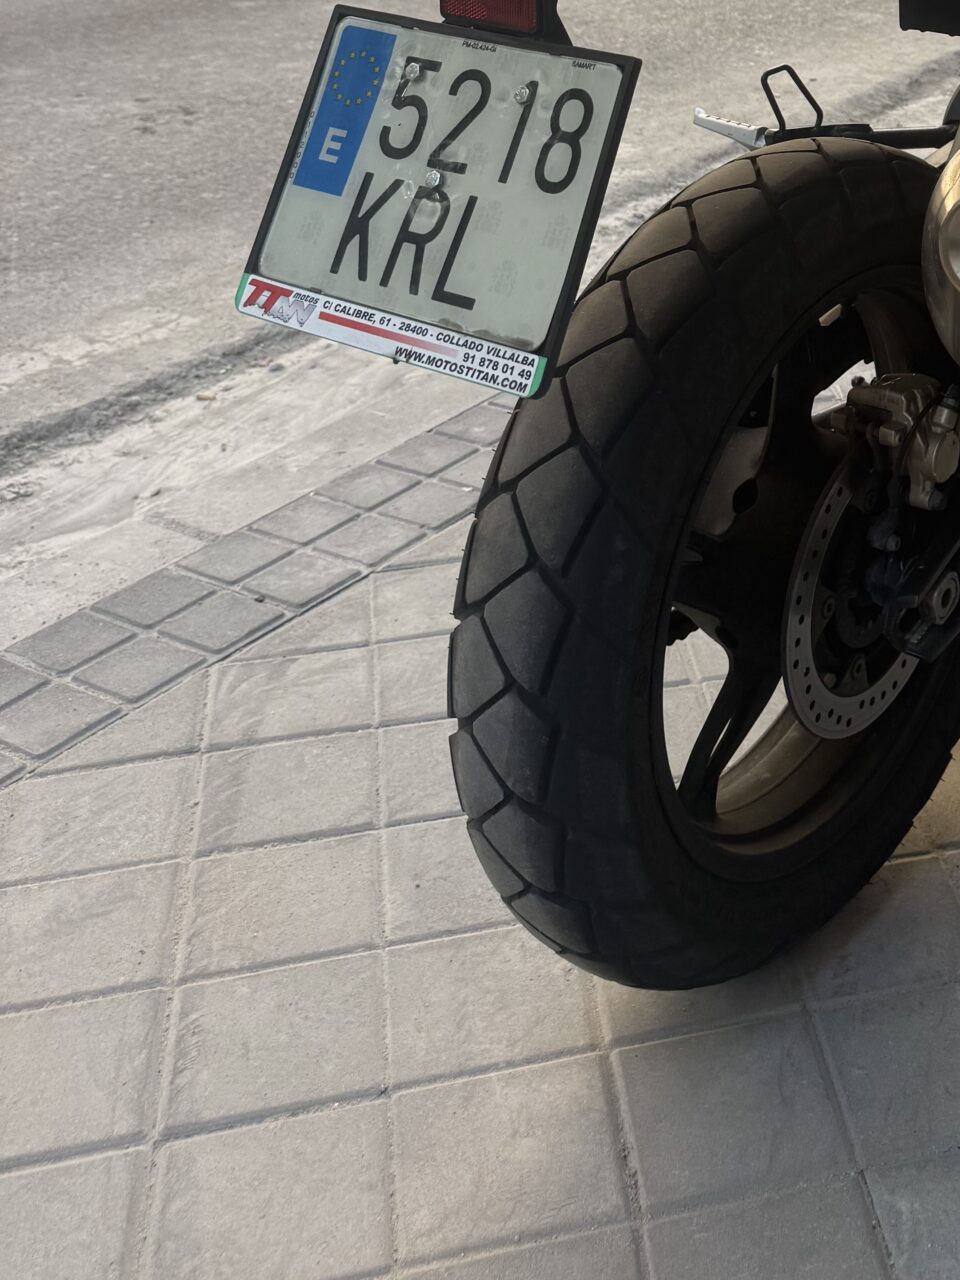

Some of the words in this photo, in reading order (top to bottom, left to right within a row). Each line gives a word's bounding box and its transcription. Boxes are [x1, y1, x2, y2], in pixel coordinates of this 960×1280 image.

[318, 126, 348, 164] E
[378, 55, 594, 194] 5218
[329, 171, 477, 311] KRL
[293, 291, 320, 305] motos
[334, 303, 376, 325] CALIBRE,
[378, 316, 391, 327] 61
[398, 321, 429, 337] 28400
[436, 332, 484, 352] COLLADO
[486, 345, 536, 367] VILLALBA
[394, 346, 529, 393] WWW.MOTOSTITAN.COM
[462, 352, 475, 364] 91
[479, 356, 499, 371] 878
[501, 363, 515, 376] 01
[517, 368, 532, 381] 49
